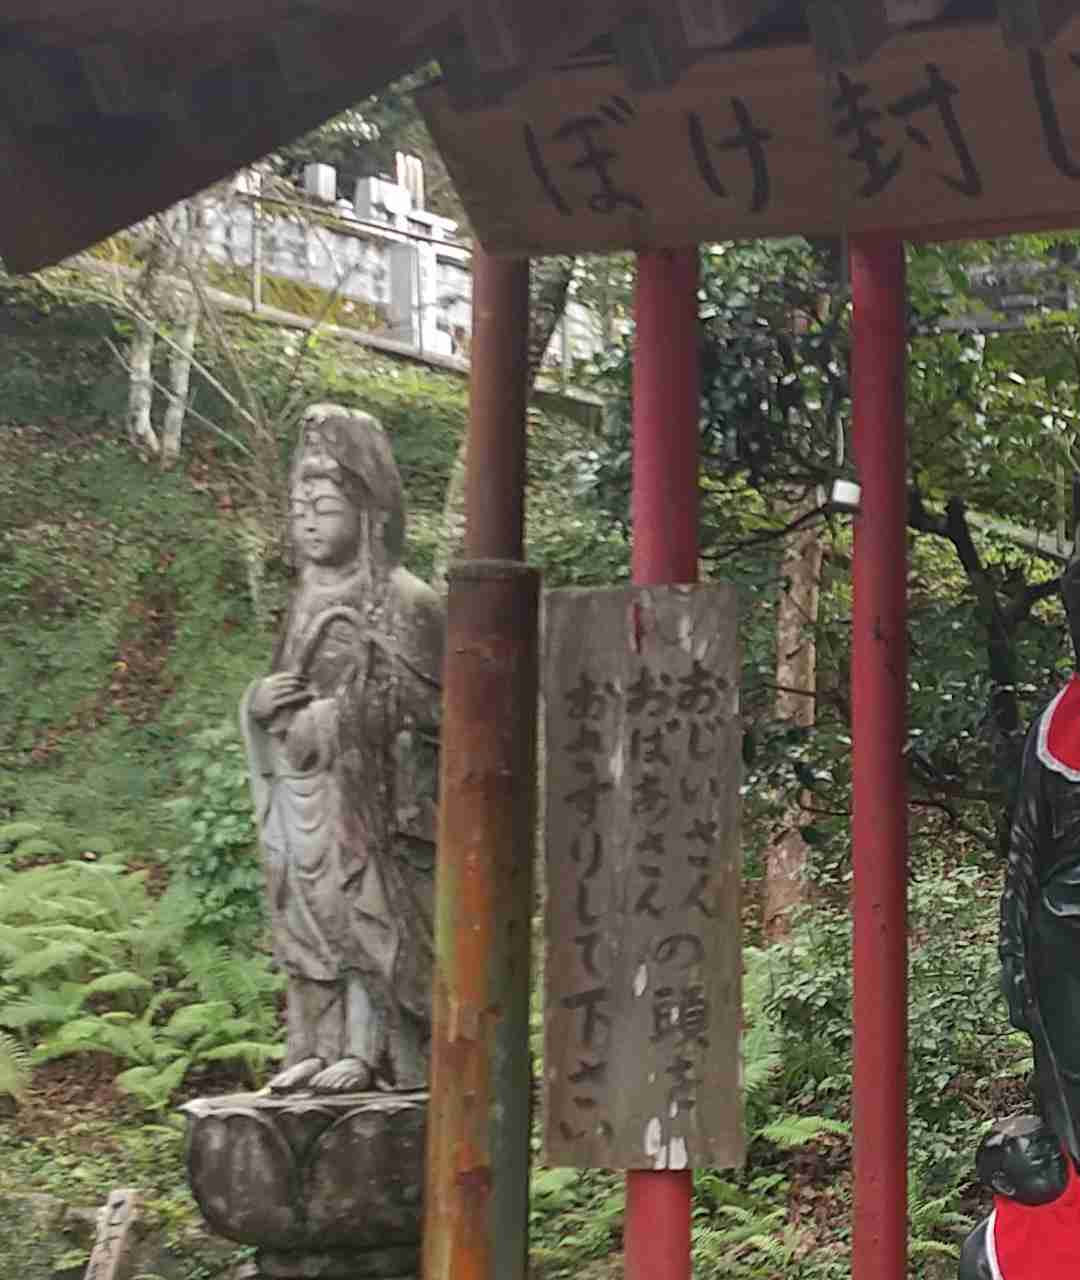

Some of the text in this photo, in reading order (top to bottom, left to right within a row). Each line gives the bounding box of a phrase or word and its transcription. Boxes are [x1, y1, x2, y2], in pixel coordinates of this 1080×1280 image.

[626, 666, 681, 919] おばあさん
[678, 660, 728, 918] おじいさん
